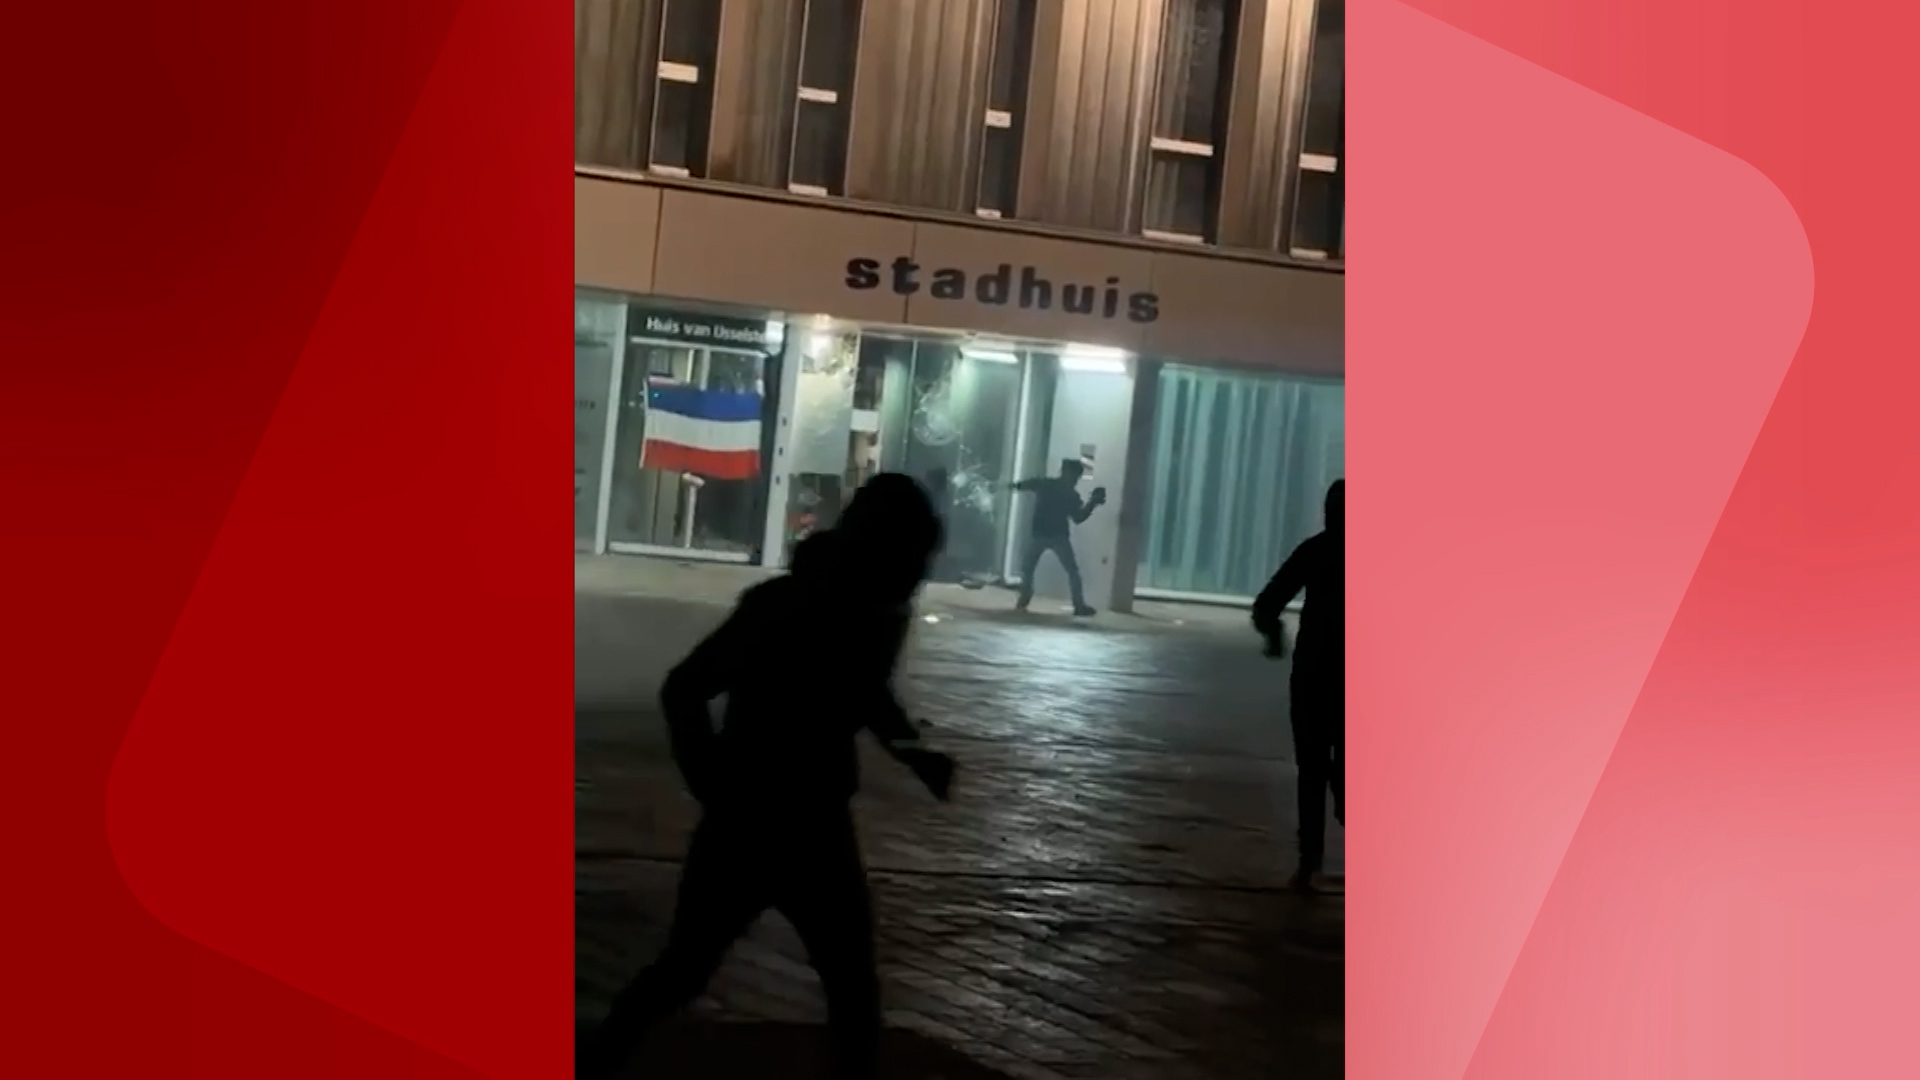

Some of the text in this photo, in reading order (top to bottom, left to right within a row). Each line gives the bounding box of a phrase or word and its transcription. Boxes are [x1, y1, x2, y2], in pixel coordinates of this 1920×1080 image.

[845, 256, 1159, 323] stadhuis
[646, 316, 679, 334] Huis
[684, 323, 710, 337] van
